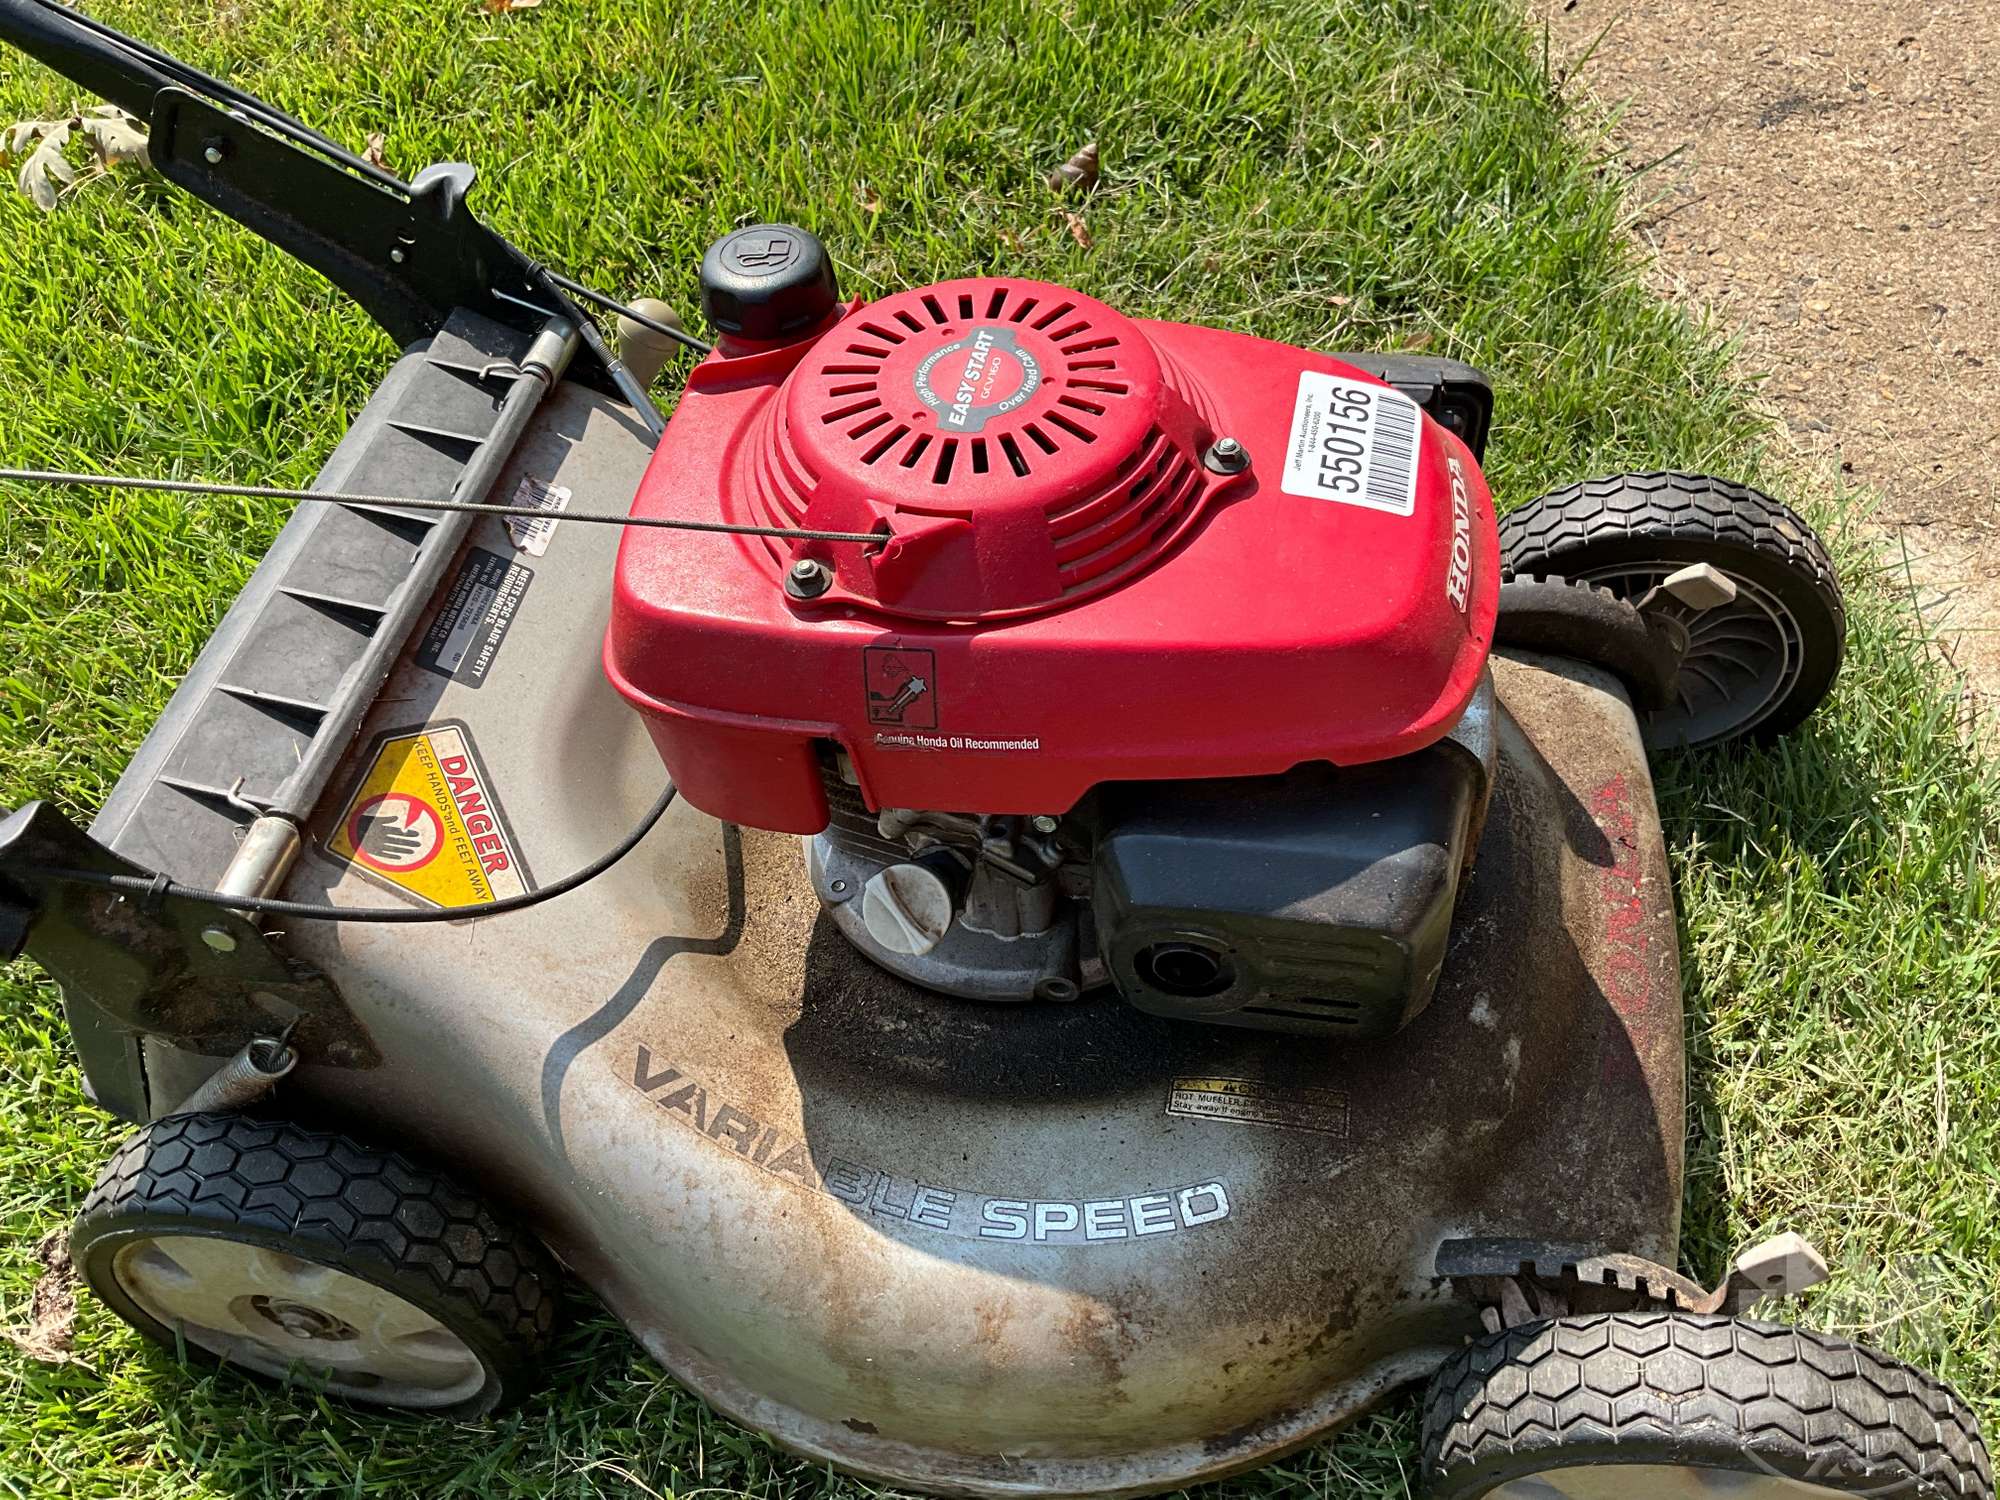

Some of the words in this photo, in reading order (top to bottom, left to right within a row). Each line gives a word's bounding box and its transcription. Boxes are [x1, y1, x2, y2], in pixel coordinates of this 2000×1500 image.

[916, 343, 961, 387] Performance
[1015, 348, 1036, 368] Cam
[948, 380, 976, 426] EASY
[964, 330, 994, 380] START
[1021, 368, 1038, 393] Head
[919, 387, 941, 407] High
[999, 392, 1026, 411] Over
[1297, 438, 1306, 458] Martin
[1318, 386, 1371, 494] 550156
[1293, 459, 1302, 472] Jeff
[1448, 457, 1470, 610] HONDA
[484, 564, 521, 625] REQUIREMENTS.
[512, 569, 530, 597] MEETS
[500, 595, 517, 619] CPSC
[486, 618, 507, 645] BLADE
[472, 643, 494, 678] SAFETY
[917, 735, 948, 748] Honda
[950, 737, 963, 749] Oil
[965, 738, 1039, 750] Recommended
[414, 739, 434, 769] KEEP
[427, 771, 451, 812] HANDS
[444, 812, 461, 835] and
[454, 837, 474, 866] FEET
[466, 868, 490, 901] AWAY
[440, 755, 510, 876] DANGER
[1174, 1092, 1194, 1101] HOT
[1198, 1094, 1240, 1106] MUFFLER
[1174, 1100, 1193, 1111] Stay
[1196, 1104, 1219, 1114] away
[633, 1044, 957, 1229] VARIABLE
[981, 1181, 1231, 1241] SPEED
